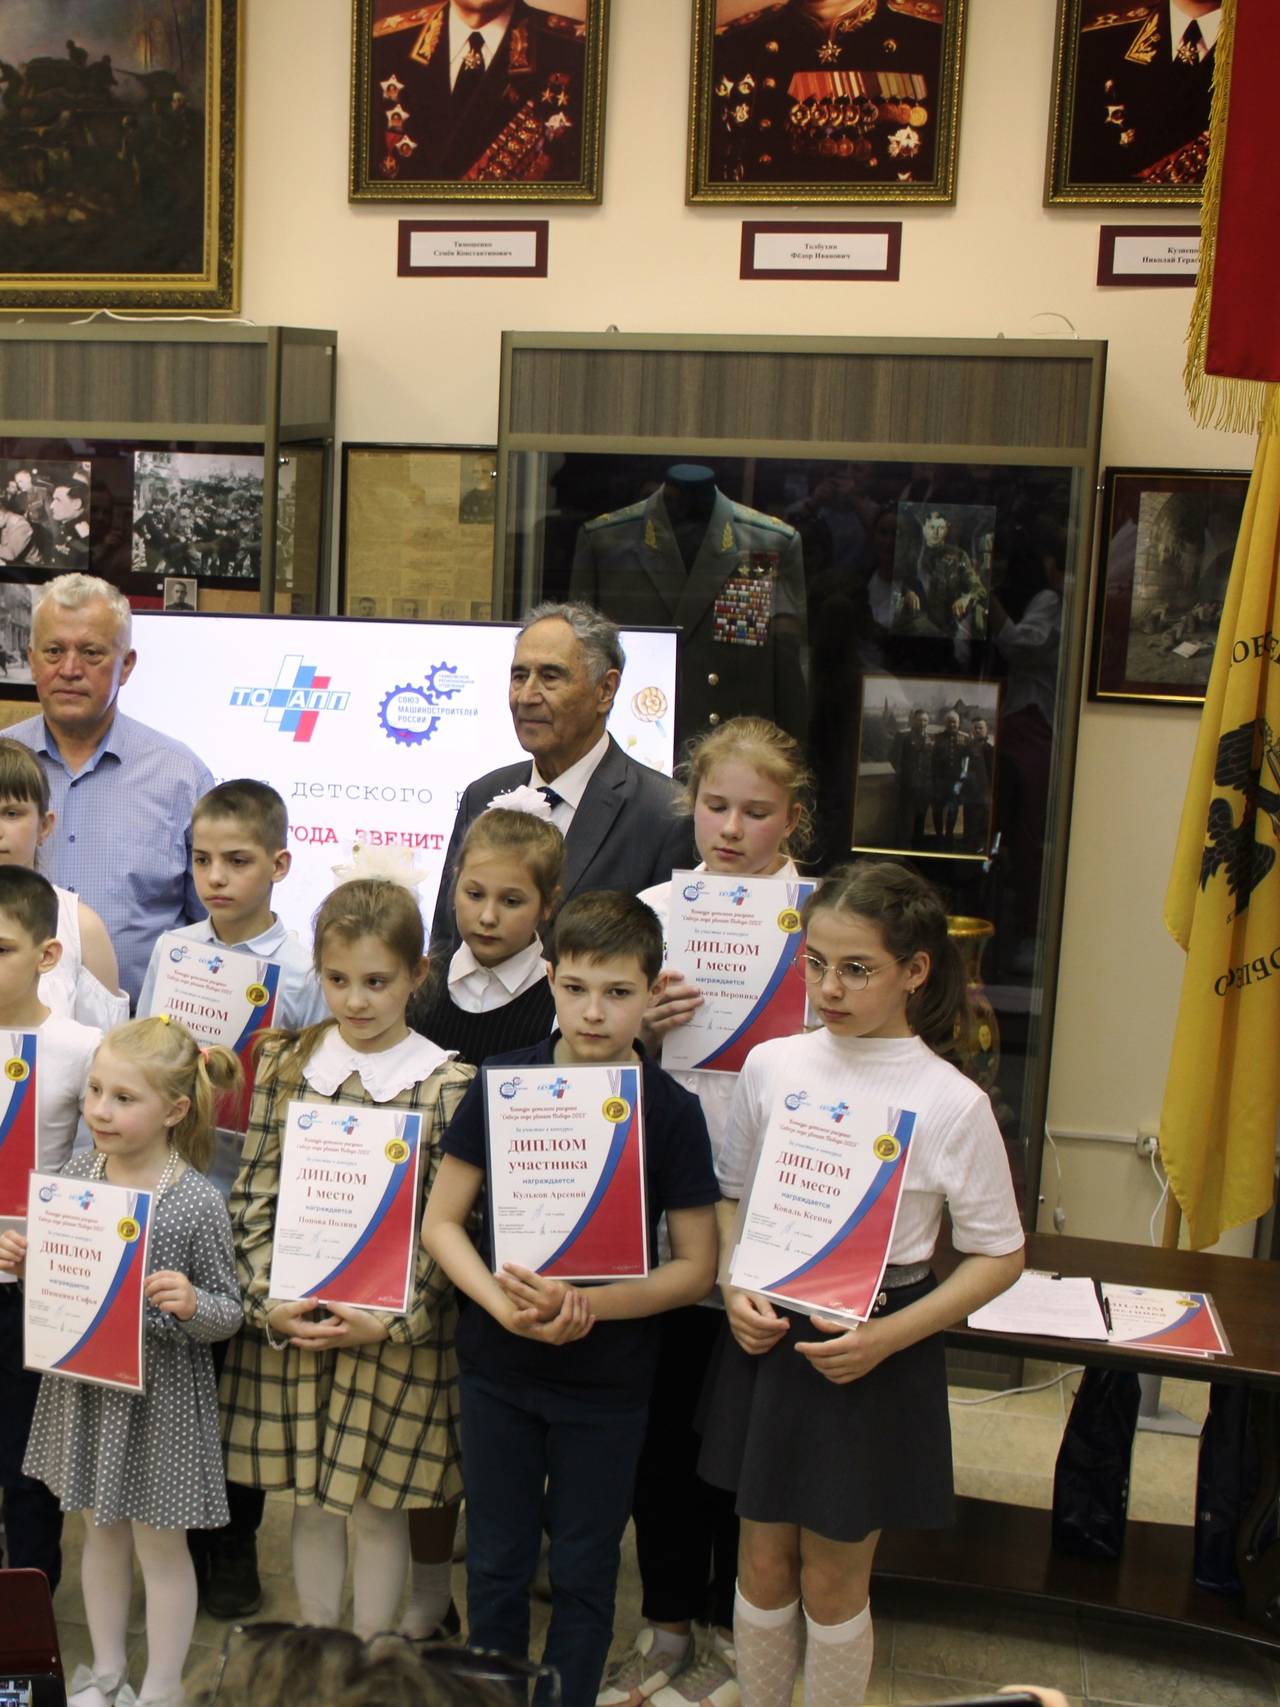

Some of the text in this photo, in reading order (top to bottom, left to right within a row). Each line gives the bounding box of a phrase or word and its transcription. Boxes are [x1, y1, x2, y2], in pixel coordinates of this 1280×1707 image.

[289, 691, 350, 710] АПП
[397, 695, 420, 705] СОЮЗ
[397, 714, 427, 723] РОССИИ
[291, 780, 433, 804] детского
[685, 939, 760, 957] ДИПЛОМ
[696, 958, 747, 974] I место
[165, 997, 229, 1022] ДИПЛОМ
[186, 1020, 222, 1037] место
[508, 1138, 587, 1154] ДИПЛОМ
[508, 1160, 588, 1174] участника
[775, 1151, 852, 1181] ДИПЛОМ
[296, 1167, 368, 1186] ДИПЛОМ
[522, 1177, 575, 1186] награждается
[778, 1170, 842, 1197] III место
[306, 1187, 355, 1202] I место
[512, 1190, 548, 1200] Кульков
[40, 1240, 103, 1263] ДИПЛОМ
[49, 1259, 91, 1278] I место
